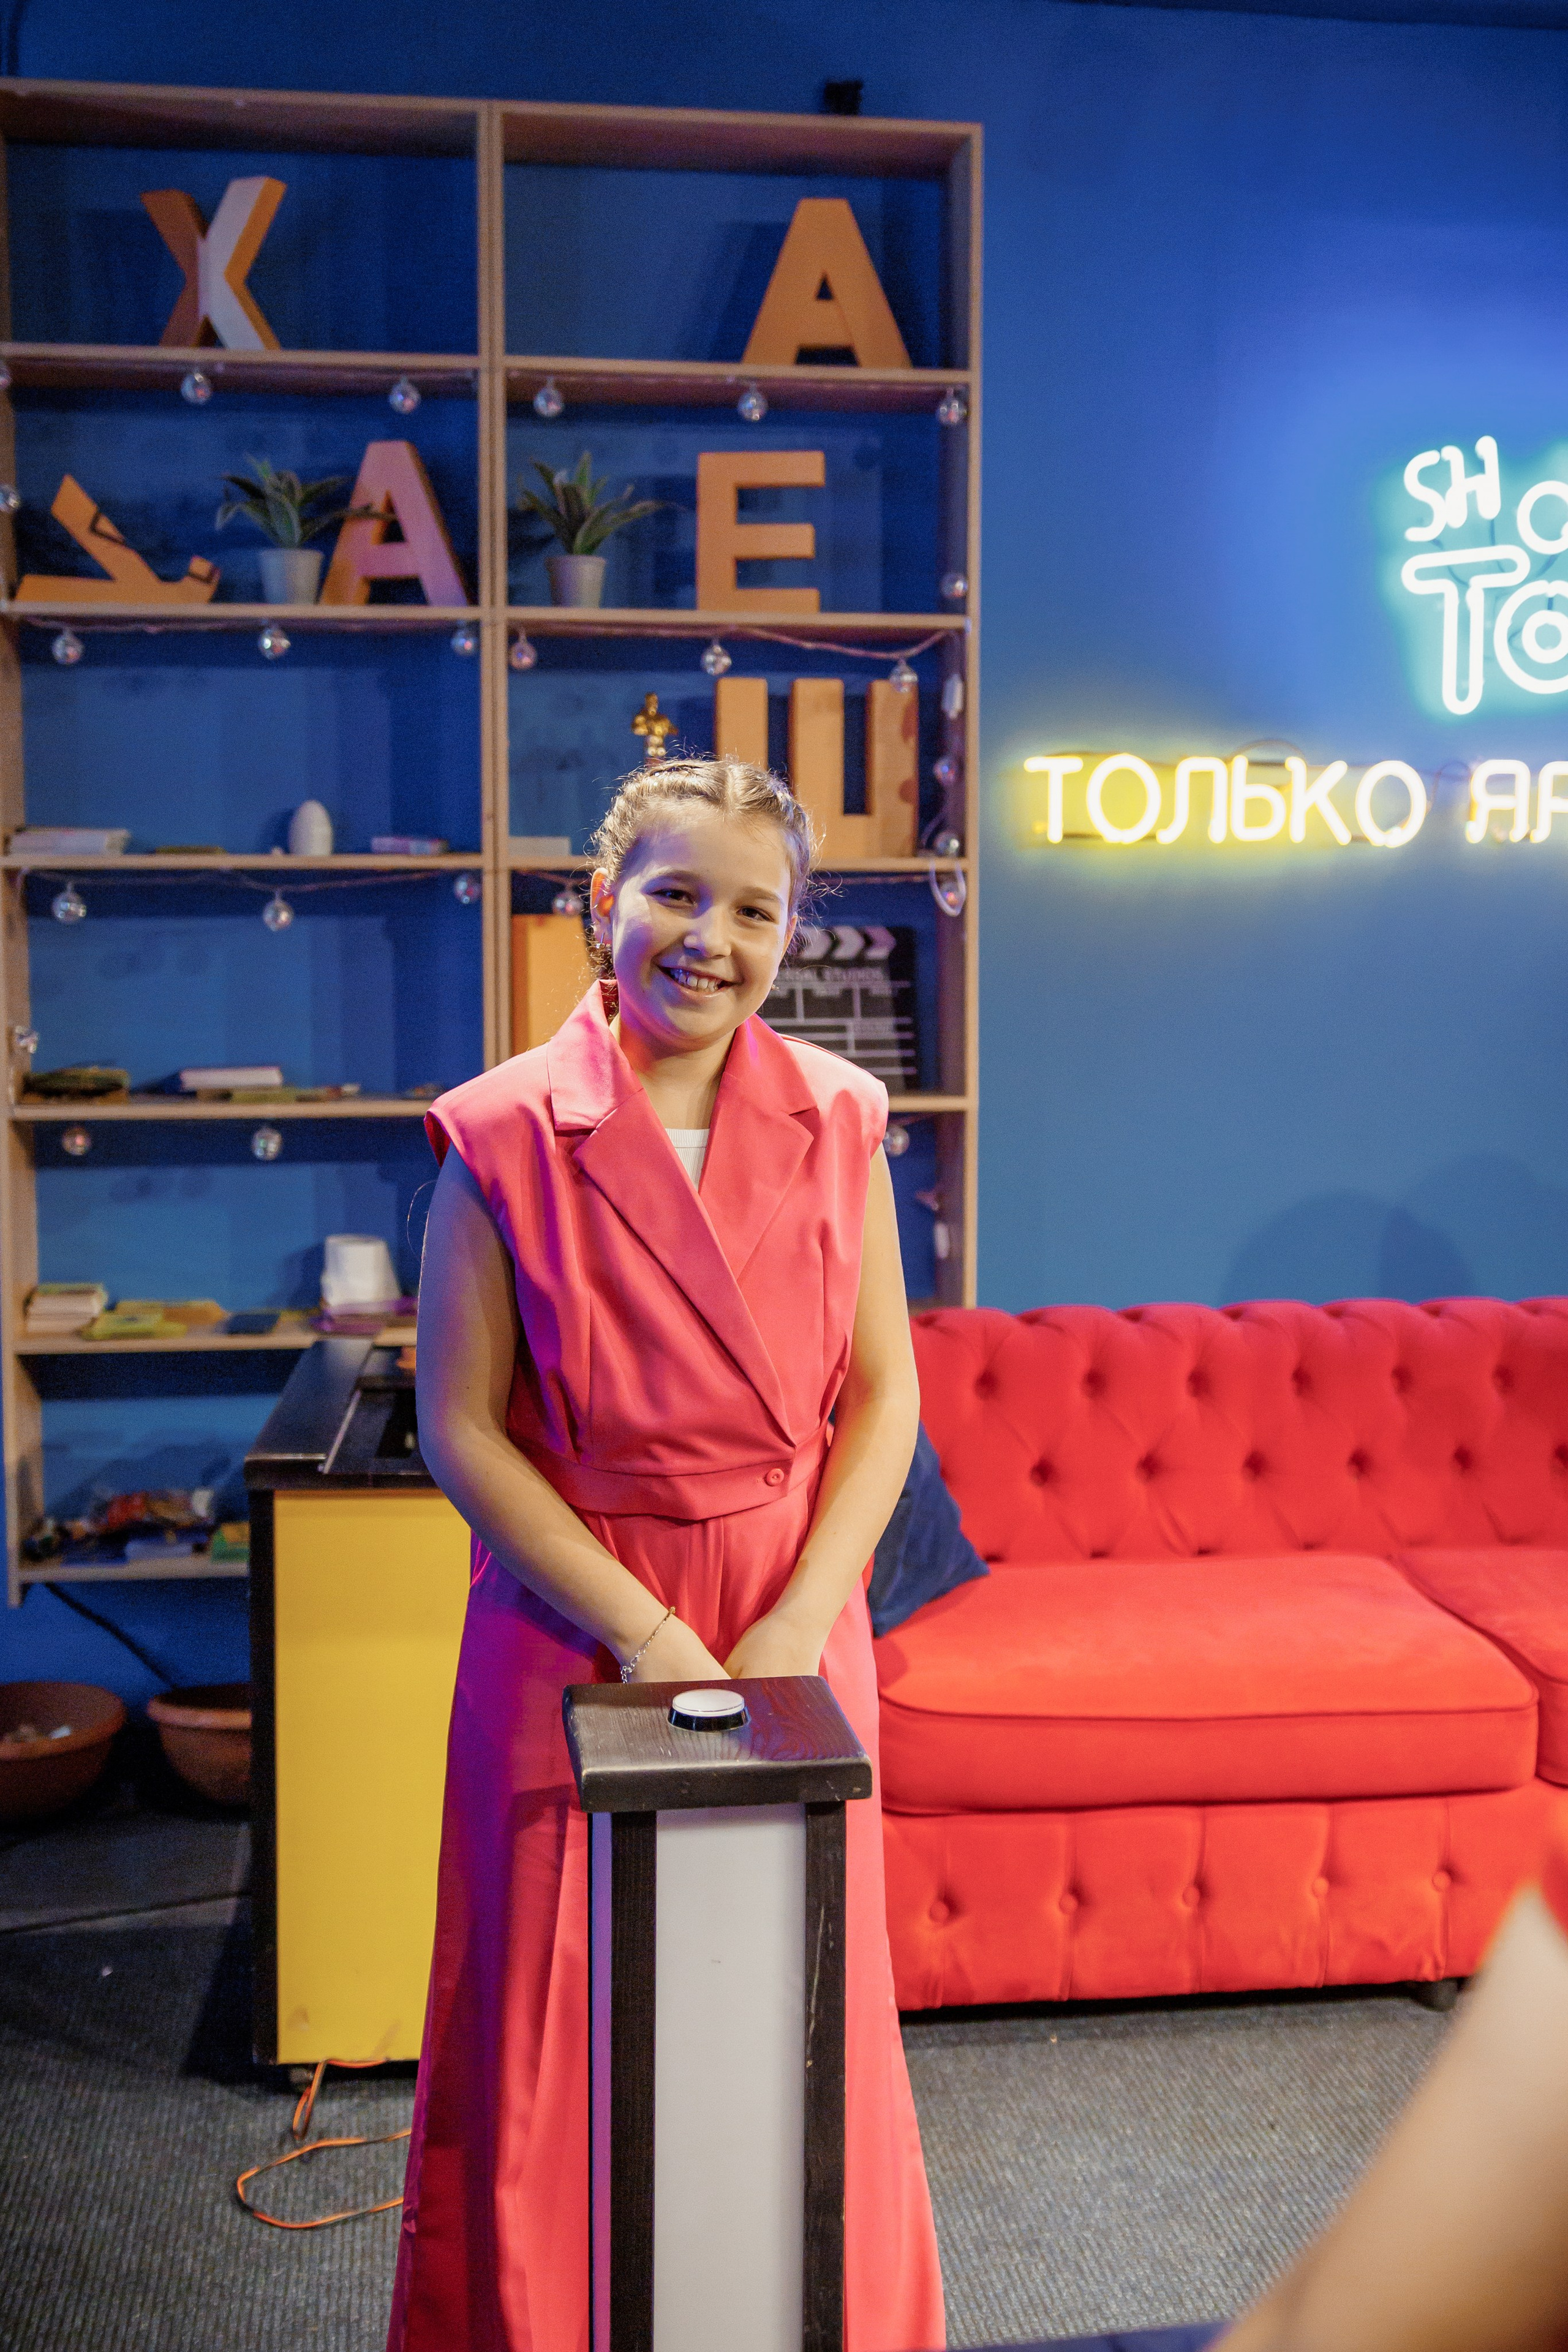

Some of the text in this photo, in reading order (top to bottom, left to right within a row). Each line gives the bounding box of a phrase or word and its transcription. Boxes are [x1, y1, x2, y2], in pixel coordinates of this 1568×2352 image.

[742, 198, 913, 368] А
[320, 440, 470, 606] А
[697, 451, 826, 611] Е
[1023, 754, 1427, 848] ТОЛЬКО
